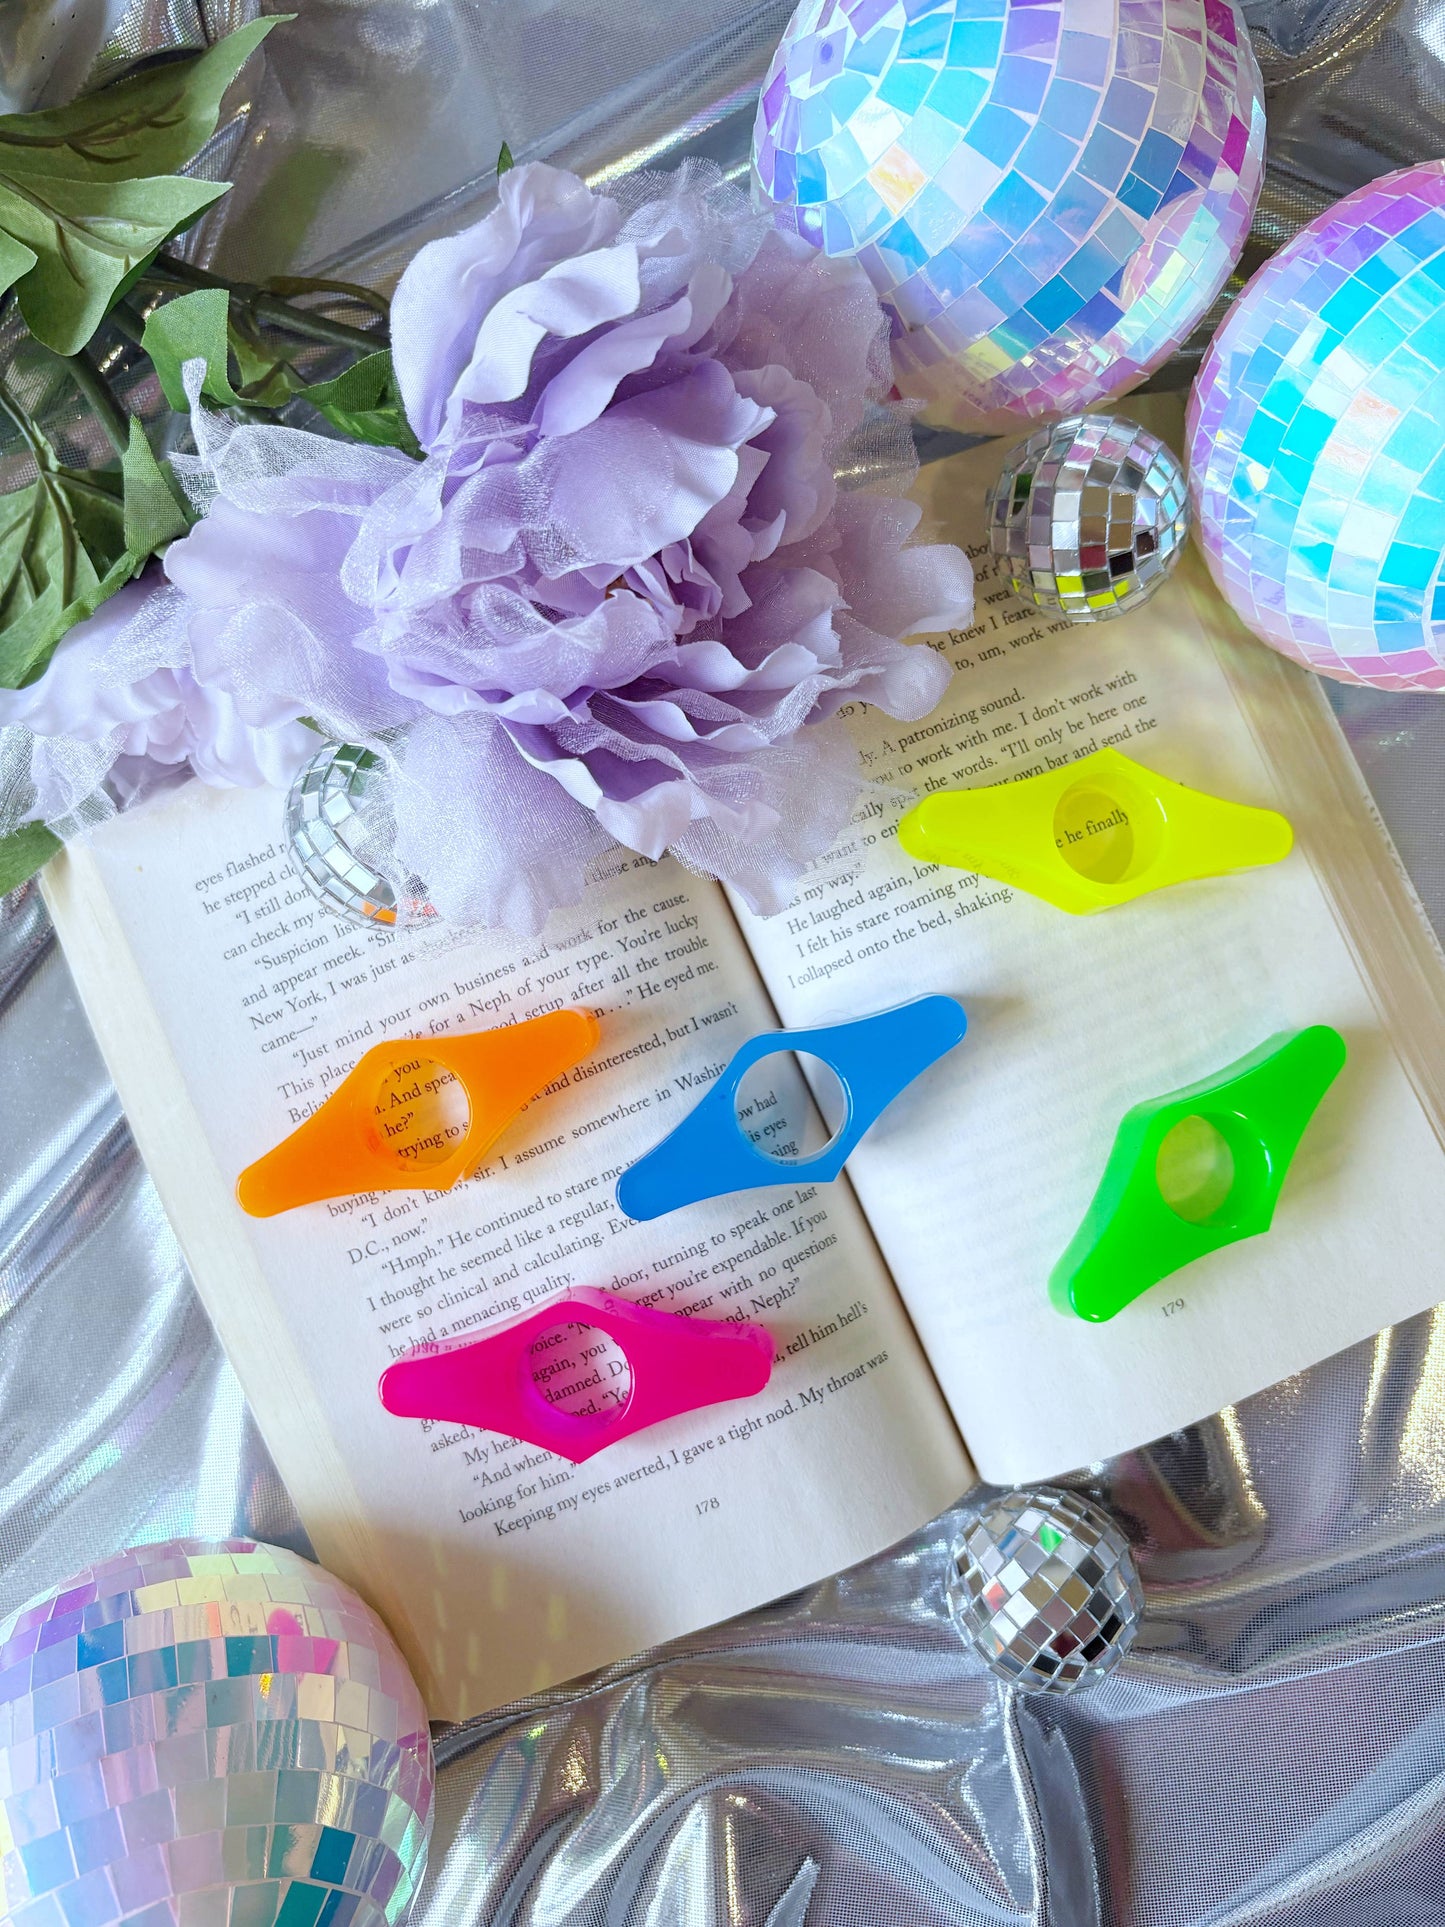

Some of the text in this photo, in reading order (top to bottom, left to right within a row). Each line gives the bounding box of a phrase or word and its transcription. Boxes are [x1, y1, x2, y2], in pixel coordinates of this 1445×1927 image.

[947, 624, 986, 646] knew
[954, 658, 975, 671] to,
[977, 646, 1006, 662] um,
[1008, 627, 1045, 649] work
[897, 709, 980, 754] patronizing
[979, 687, 1025, 716] sound.
[916, 670, 1138, 768] work with me. don't work with
[923, 776, 949, 793] the
[951, 755, 998, 780] words.
[1034, 727, 1062, 748] only
[1086, 707, 1119, 726] here
[1122, 696, 1147, 712] one
[1044, 718, 1157, 770] bar and send the
[195, 873, 224, 891] eyes
[226, 843, 276, 878] flashed
[202, 871, 277, 915] he stepped
[254, 896, 281, 919] still
[787, 918, 809, 935] He
[809, 889, 865, 925] laughed
[867, 876, 913, 901] again,
[912, 863, 940, 880] low
[223, 944, 248, 960] can
[250, 921, 291, 948] check
[293, 912, 314, 930] my
[798, 888, 1014, 985] collapsed onto the bed, shaking.
[807, 935, 829, 954] felt
[830, 927, 853, 943] his
[856, 911, 891, 932] stare
[893, 883, 957, 917] roaming
[242, 945, 365, 1007] and appear meek.
[249, 958, 397, 1030] New York, was just
[277, 1078, 315, 1099] This
[319, 1060, 356, 1088] place
[429, 1018, 450, 1036] for
[467, 990, 512, 1017] Neph
[517, 977, 533, 996] of
[536, 966, 571, 993] your
[575, 950, 614, 974] type.
[615, 929, 663, 953] You're
[664, 914, 699, 935] lucky
[335, 1020, 374, 1049] mind
[379, 1007, 411, 1034] your
[418, 992, 450, 1012] own
[453, 963, 516, 996] business
[597, 919, 619, 936] for
[623, 908, 648, 924] the
[652, 894, 690, 913] cause.
[393, 1060, 421, 1083] you
[524, 997, 564, 1021] setup
[570, 979, 605, 1001] after
[611, 964, 631, 984] all
[635, 957, 660, 973] the
[664, 935, 709, 962] trouble
[390, 961, 719, 1109] And He eyed me.
[397, 1001, 739, 1159] trying to and disinterested, but wasn't
[383, 1196, 419, 1221] don't
[473, 1167, 496, 1182] sir.
[514, 1135, 566, 1164] assume
[571, 1097, 651, 1139] somewhere
[655, 1088, 672, 1102] in
[447, 1230, 473, 1249] He
[475, 1195, 545, 1238] continued
[546, 1193, 563, 1206] to
[564, 1176, 599, 1199] stare
[753, 1090, 778, 1113] had
[326, 1191, 380, 1217] buying
[380, 1118, 788, 1306] thought he seemed like regular, eyes
[611, 1269, 649, 1291] door,
[651, 1241, 710, 1273] turning
[729, 1209, 770, 1240] speak
[771, 1199, 795, 1217] one
[794, 1186, 818, 1205] last
[378, 1232, 605, 1334] were so clinical and calculating.
[665, 1269, 710, 1301] you're
[711, 1230, 792, 1275] expendable.
[805, 1210, 828, 1233] you
[387, 1344, 406, 1359] he
[409, 1326, 438, 1349] had
[451, 1295, 522, 1333] menacing
[522, 1272, 575, 1305] quality.
[532, 1233, 838, 1383] again, you with questions
[1161, 1298, 1185, 1317] 179
[430, 1423, 475, 1453] asked,
[544, 1368, 607, 1404] damned.
[513, 1450, 553, 1472] when
[785, 1332, 810, 1355] tell
[808, 1322, 839, 1344] him
[836, 1300, 868, 1328] hell's
[493, 1350, 889, 1537] Keeping eyes averted, gave tight nod. throat was
[458, 1494, 517, 1524] looking
[516, 1483, 537, 1500] for
[695, 1497, 720, 1515] 178
